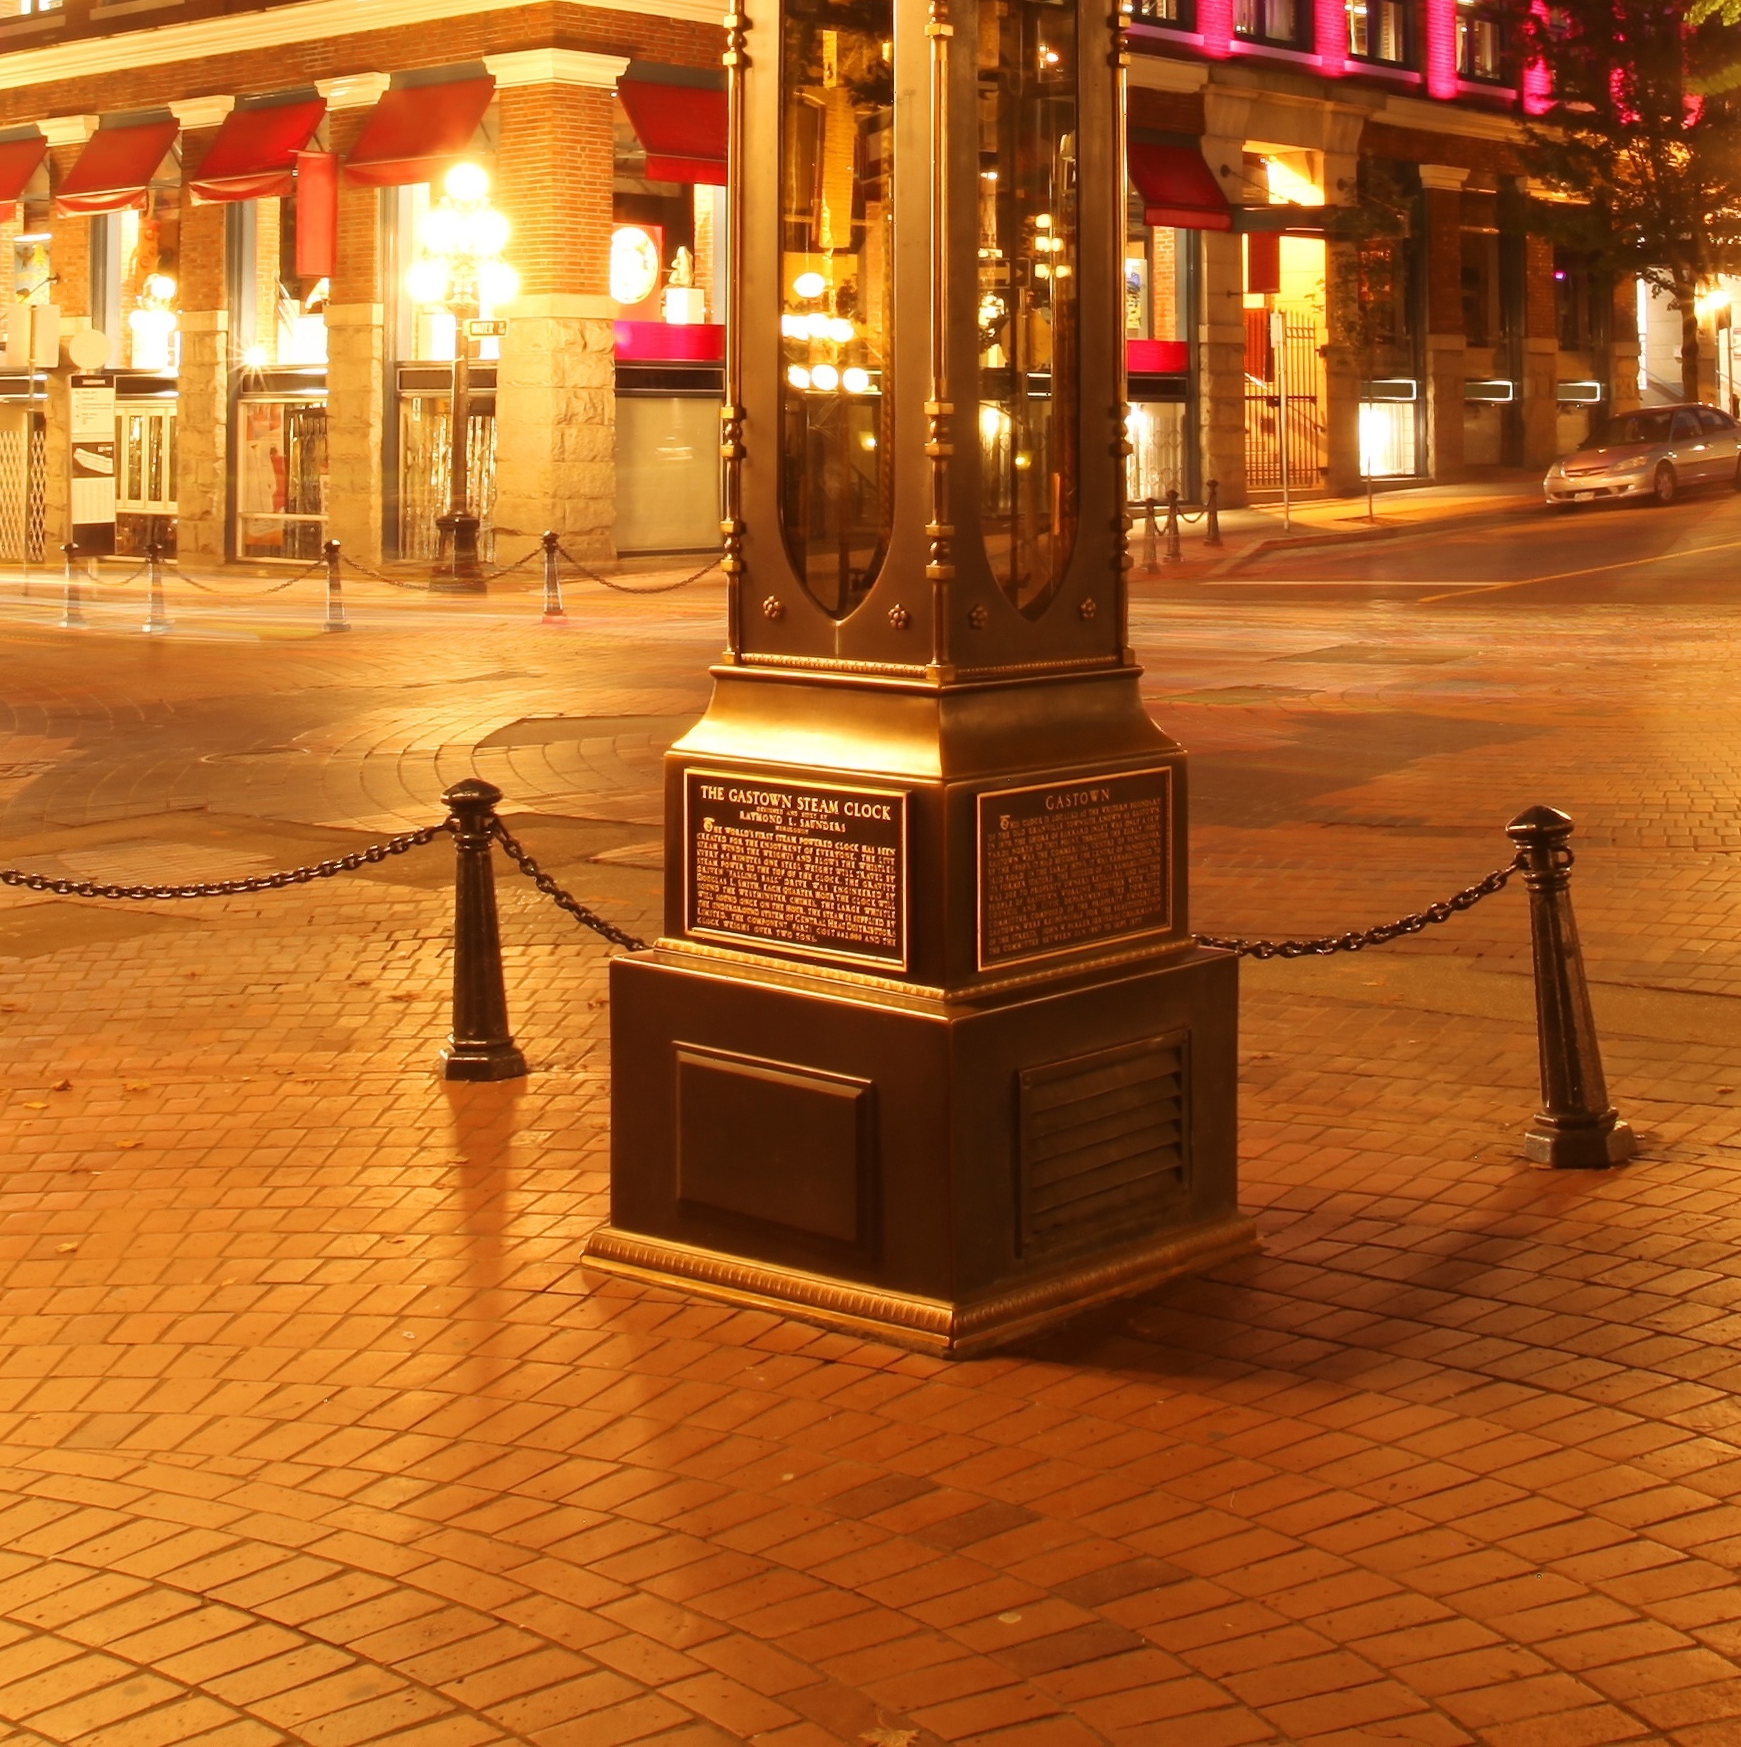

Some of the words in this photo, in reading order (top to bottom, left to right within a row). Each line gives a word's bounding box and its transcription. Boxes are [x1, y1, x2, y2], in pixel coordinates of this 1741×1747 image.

[701, 785, 723, 801] THE
[728, 788, 791, 809] GASTOWN
[797, 795, 838, 814] STEAM
[844, 800, 890, 819] CLOCK
[1045, 787, 1109, 810] GASTOWN
[739, 810, 782, 825] RAYMOND
[789, 816, 795, 826] L.
[799, 817, 845, 832] SAUNDERS
[696, 832, 726, 843] CREATED
[729, 836, 742, 845] FOR
[745, 838, 758, 847] THE
[760, 840, 801, 852] ENJOYMENT
[804, 846, 813, 854] OF
[861, 853, 874, 862] THE
[755, 831, 773, 841] FIRST
[775, 833, 796, 843] STEAM
[799, 836, 832, 848] POWERED
[834, 841, 858, 851] CLOCK
[861, 844, 874, 853] HAS
[877, 846, 895, 856] BEEN
